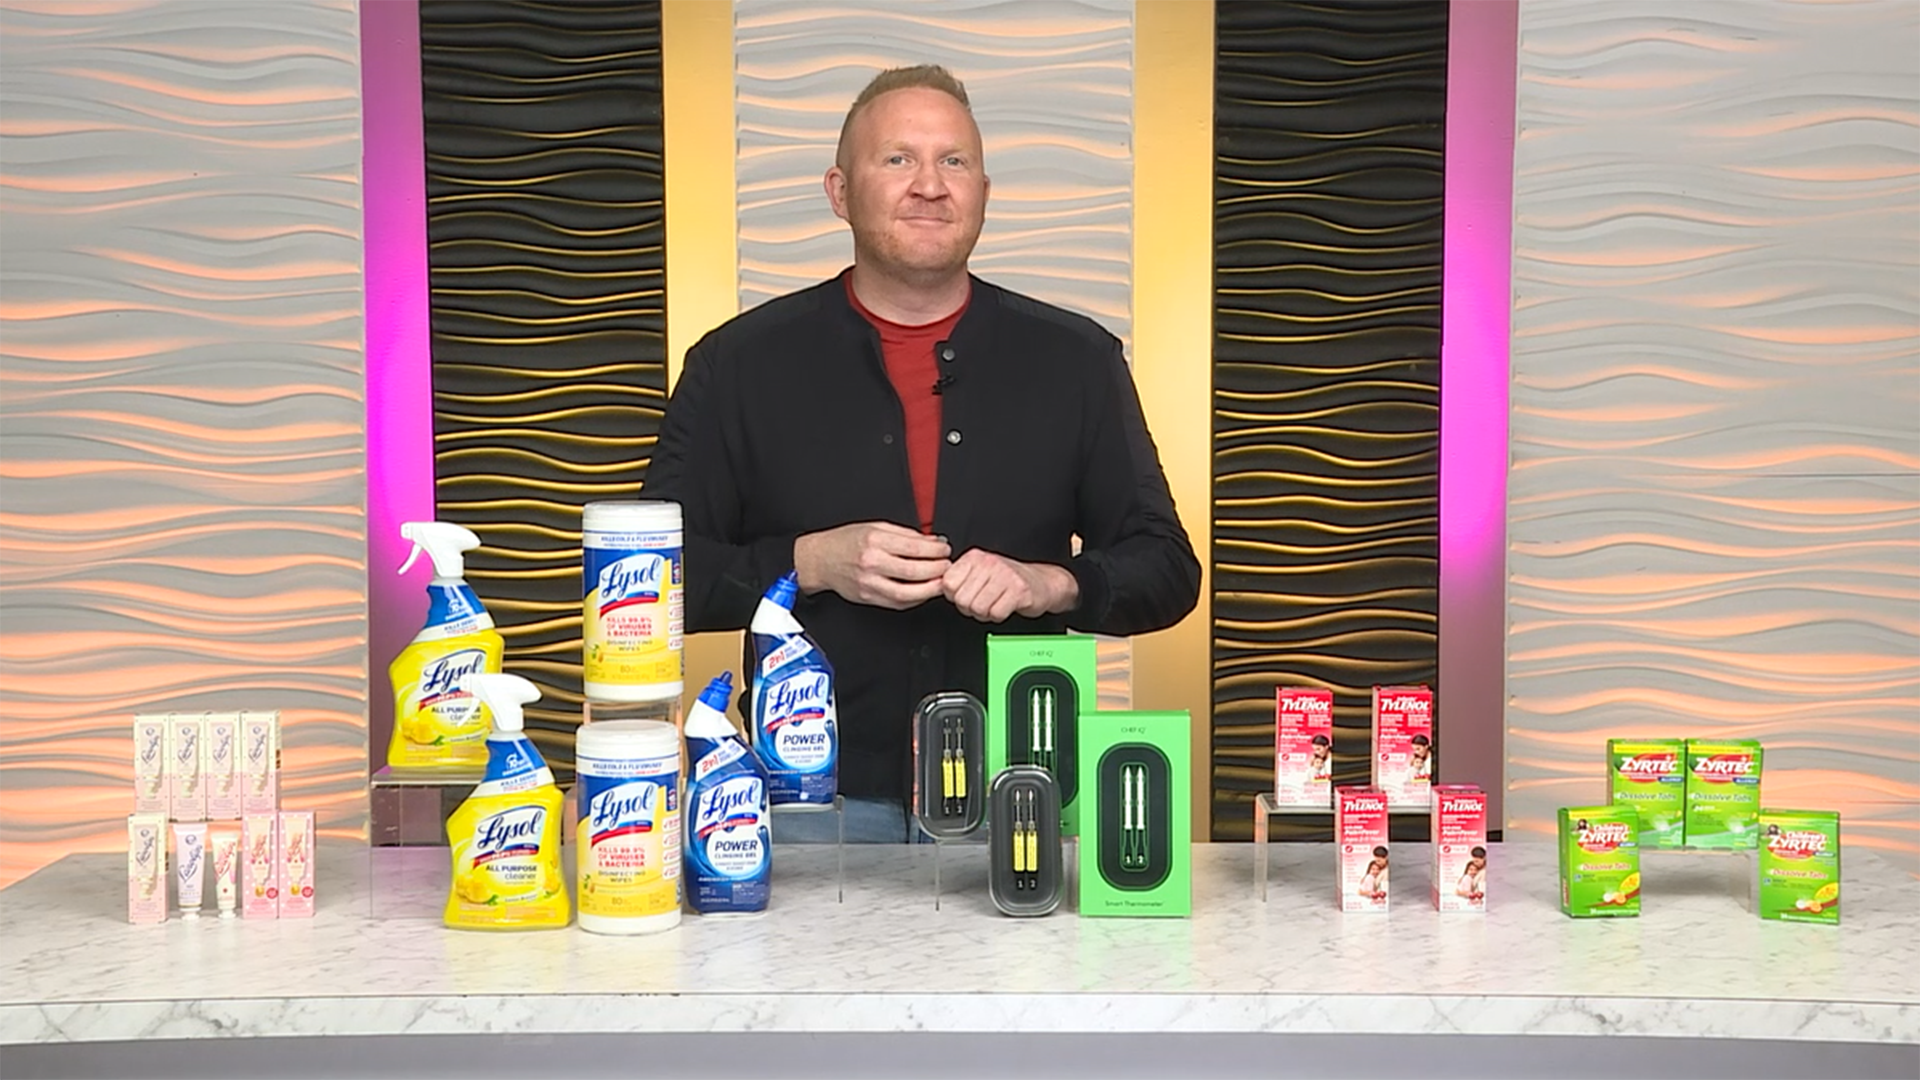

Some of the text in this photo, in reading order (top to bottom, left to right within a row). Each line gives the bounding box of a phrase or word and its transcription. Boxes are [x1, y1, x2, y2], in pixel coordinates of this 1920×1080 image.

[600, 556, 661, 599] Lysol
[423, 654, 483, 693] Lysol
[769, 674, 826, 716] Lysol
[1281, 698, 1330, 711] TYLENOL
[1380, 698, 1430, 711] TYLENOL
[783, 734, 825, 746] POWER
[1620, 755, 1678, 774] ZYRTEC
[1694, 756, 1754, 774] ZYRTEC
[702, 780, 760, 821] Lysol
[1620, 792, 1677, 801] Dissolve Tabs
[1693, 792, 1752, 802] Dissolve Tabs
[593, 784, 654, 829] Lysol
[1344, 801, 1384, 812] TYLENOL
[1442, 801, 1483, 812] TYLENOL
[477, 811, 542, 850] Lysol
[1578, 829, 1630, 843] ZYRTEC
[715, 840, 758, 852] POWER
[1768, 835, 1827, 851] ZYRTEC
[1582, 863, 1613, 871] Dissolve
[1773, 868, 1827, 879] Dissolve Tabs
